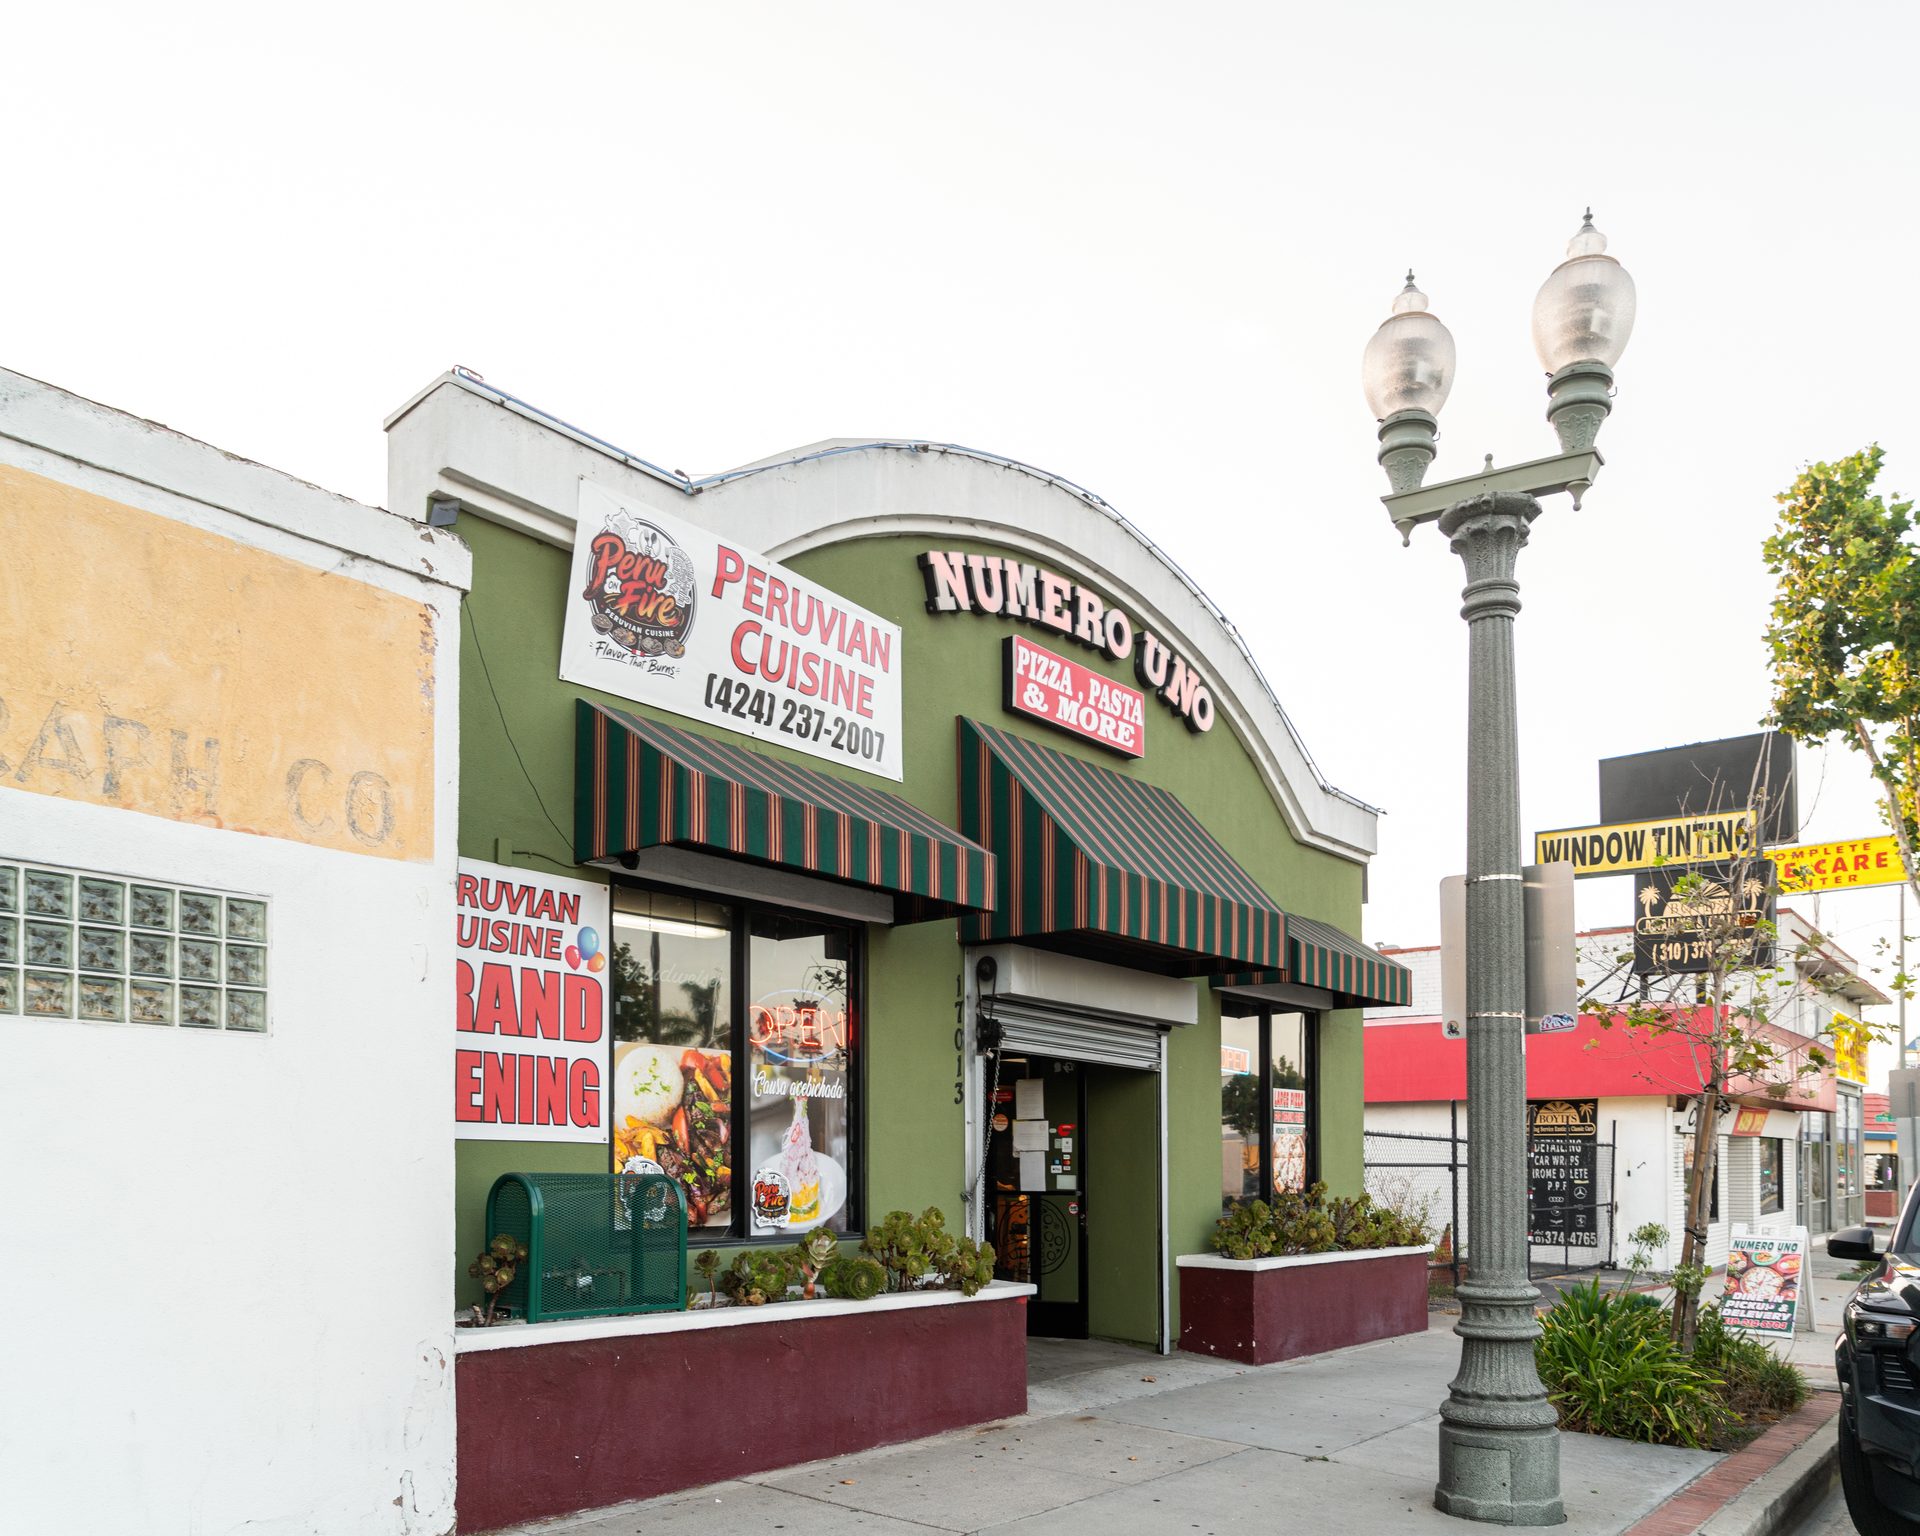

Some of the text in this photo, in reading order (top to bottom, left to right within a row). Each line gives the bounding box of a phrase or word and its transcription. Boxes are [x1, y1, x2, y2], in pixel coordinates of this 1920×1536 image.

[584, 532, 667, 600] Peru
[605, 608, 675, 637] PERUVIAN CUISINE
[617, 580, 684, 627] Fire
[711, 544, 891, 673] PERUVIAN
[595, 641, 675, 676] Flavor That Burns
[920, 551, 1215, 732] NUMERO UNO
[731, 620, 875, 720] CUISINE
[704, 673, 885, 763] (424) 237-2007
[1023, 683, 1135, 748] & MORE
[1089, 678, 1144, 727] PASTA
[1542, 817, 1750, 867] WINDOW TINTING
[1814, 852, 1888, 875] CARE
[750, 1005, 845, 1047] OPEN
[954, 974, 964, 1105] 17013
[752, 1070, 787, 1098] Causa
[1534, 1155, 1550, 1166] CAR
[1559, 1168, 1588, 1179] DLETE
[1733, 1240, 1798, 1252] NUMERO UNO
[1721, 1308, 1792, 1321] DELEVERY
[1725, 1300, 1789, 1312] PICKUP &
